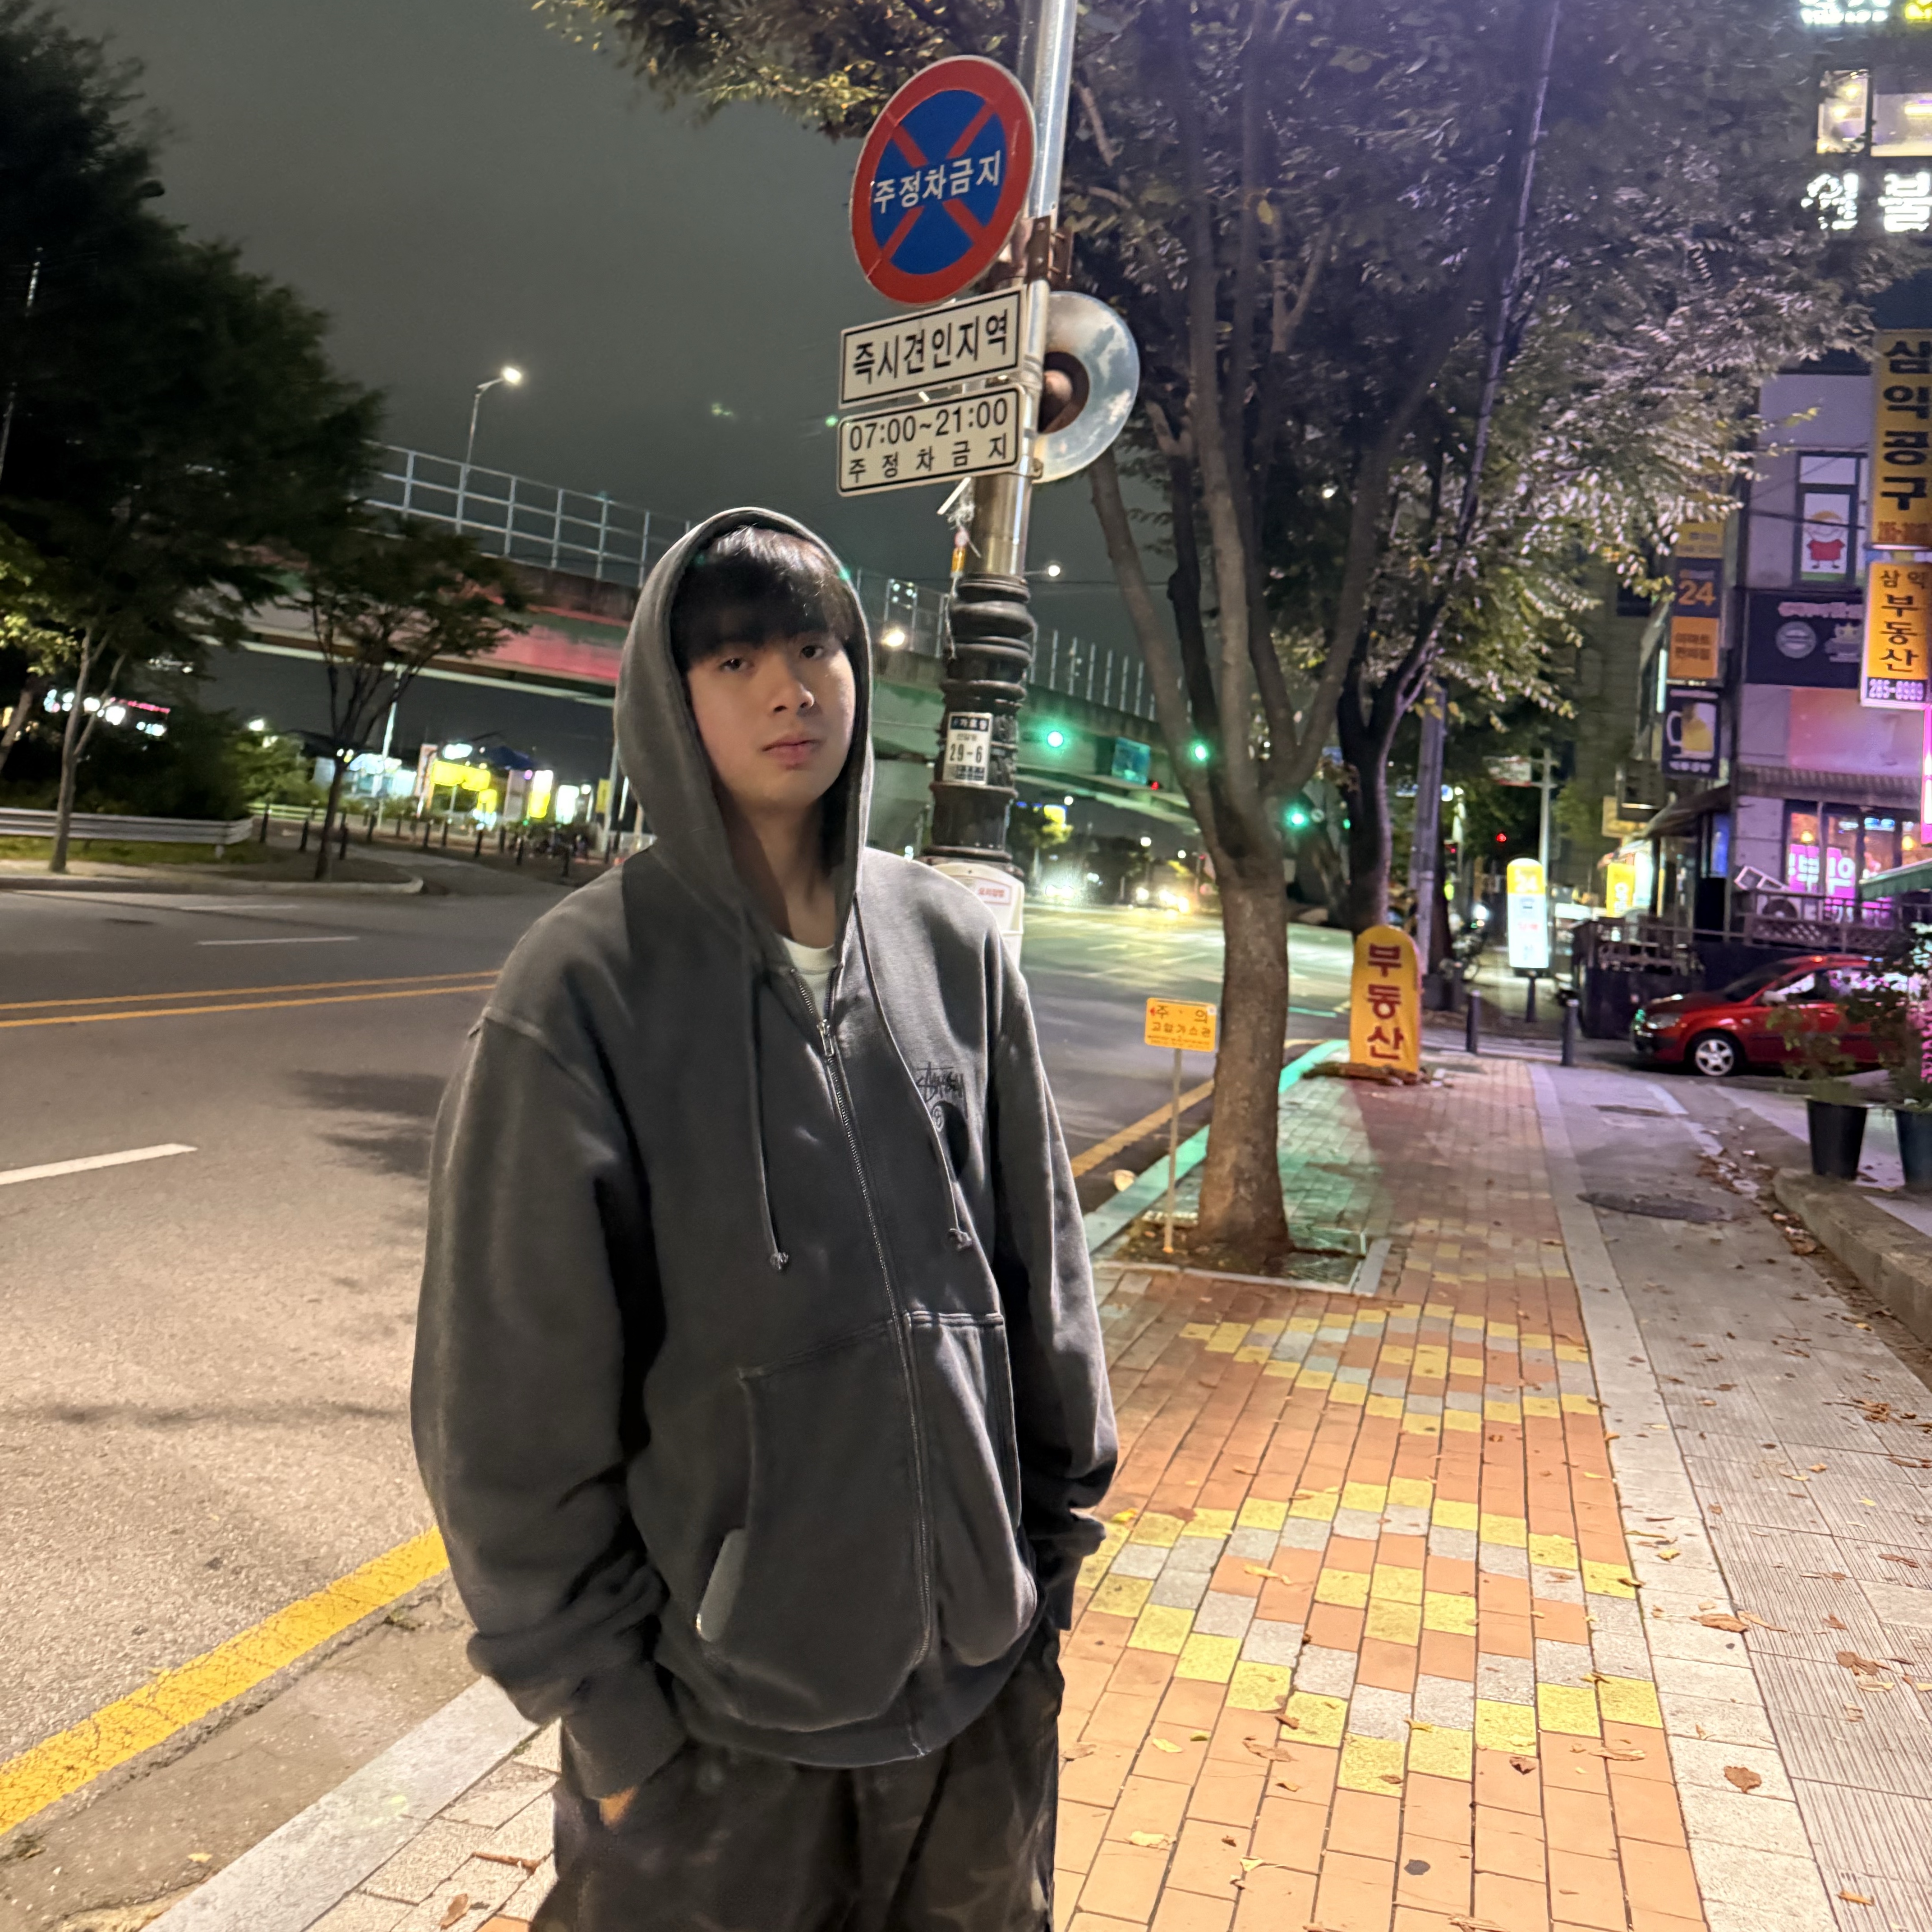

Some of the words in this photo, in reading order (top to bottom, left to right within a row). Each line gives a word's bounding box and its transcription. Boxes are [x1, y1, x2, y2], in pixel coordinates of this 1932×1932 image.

[874, 150, 1001, 214] 주정차금지
[853, 309, 1007, 384] 즉시견인지역
[850, 398, 1007, 451] 07:00~21:00
[1678, 580, 1716, 606] 24
[1878, 594, 1920, 672] 부동산
[949, 744, 983, 764] 29-6
[1367, 943, 1404, 1060] 부동산
